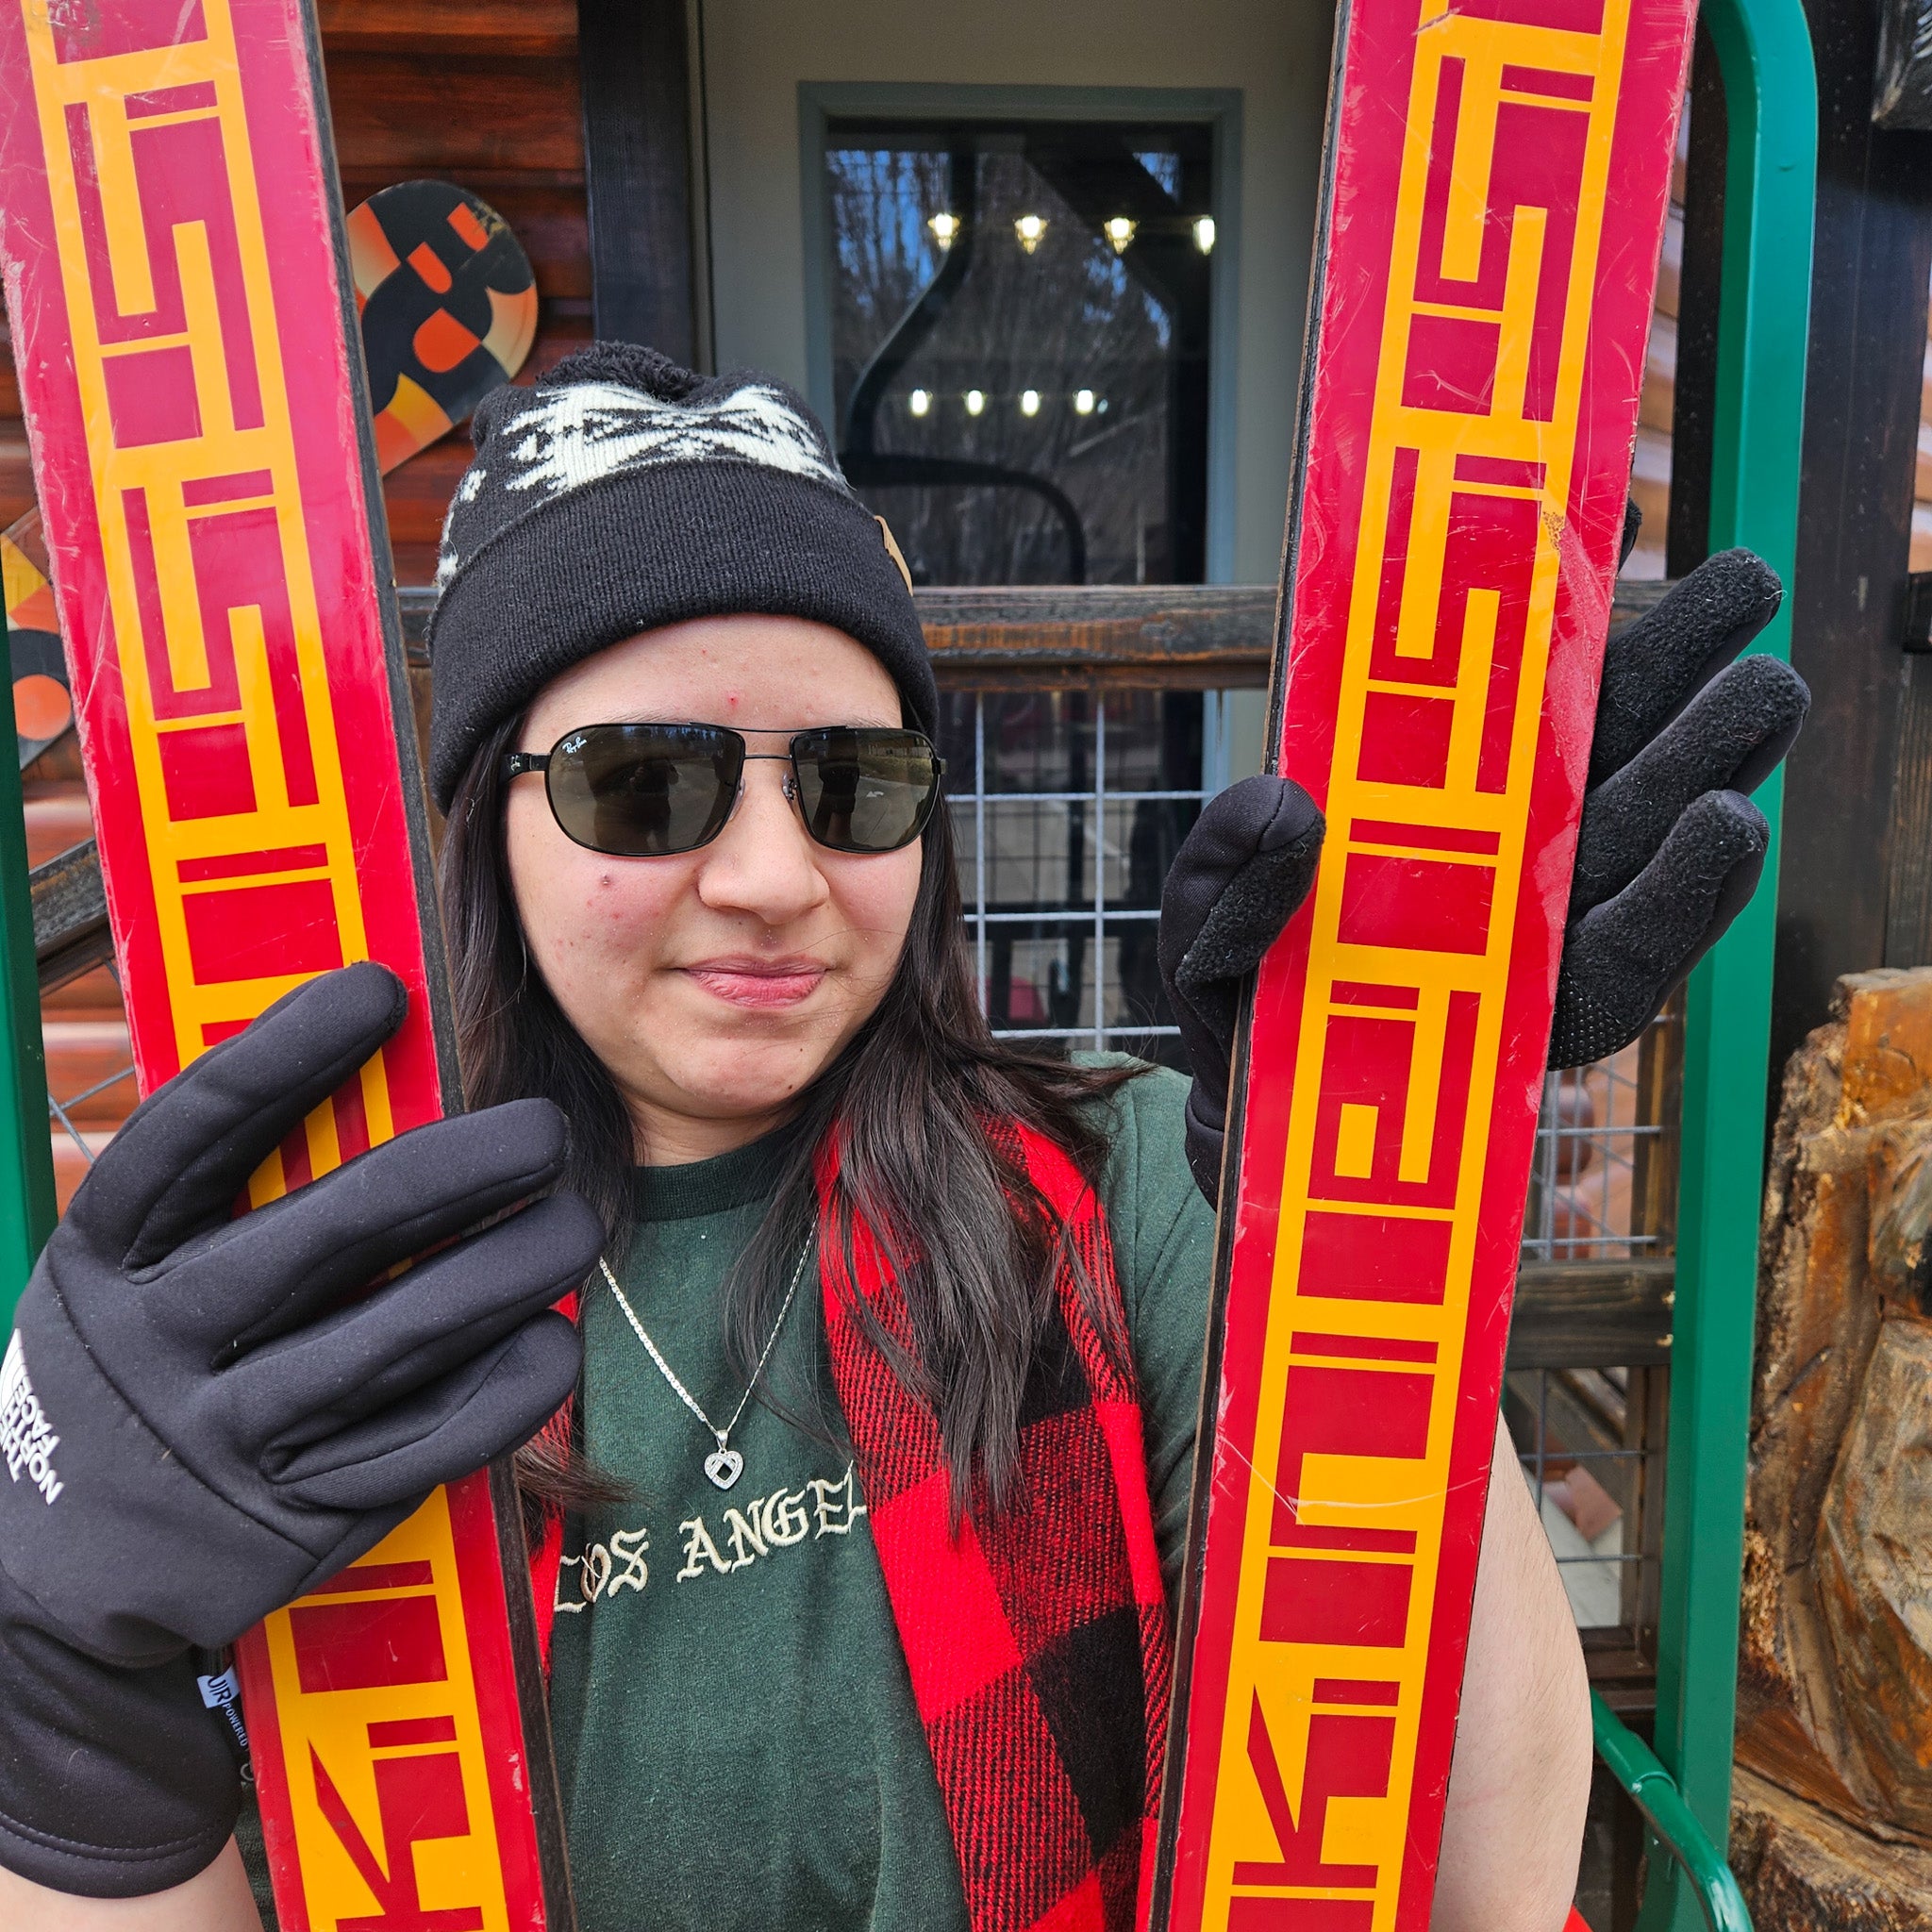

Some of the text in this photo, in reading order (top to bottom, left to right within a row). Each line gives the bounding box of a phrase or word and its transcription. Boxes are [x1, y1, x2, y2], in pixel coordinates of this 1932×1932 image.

[6, 1398, 64, 1505] NORTH
[13, 1374, 60, 1458] FACE
[222, 1702, 248, 1747] POWERED
